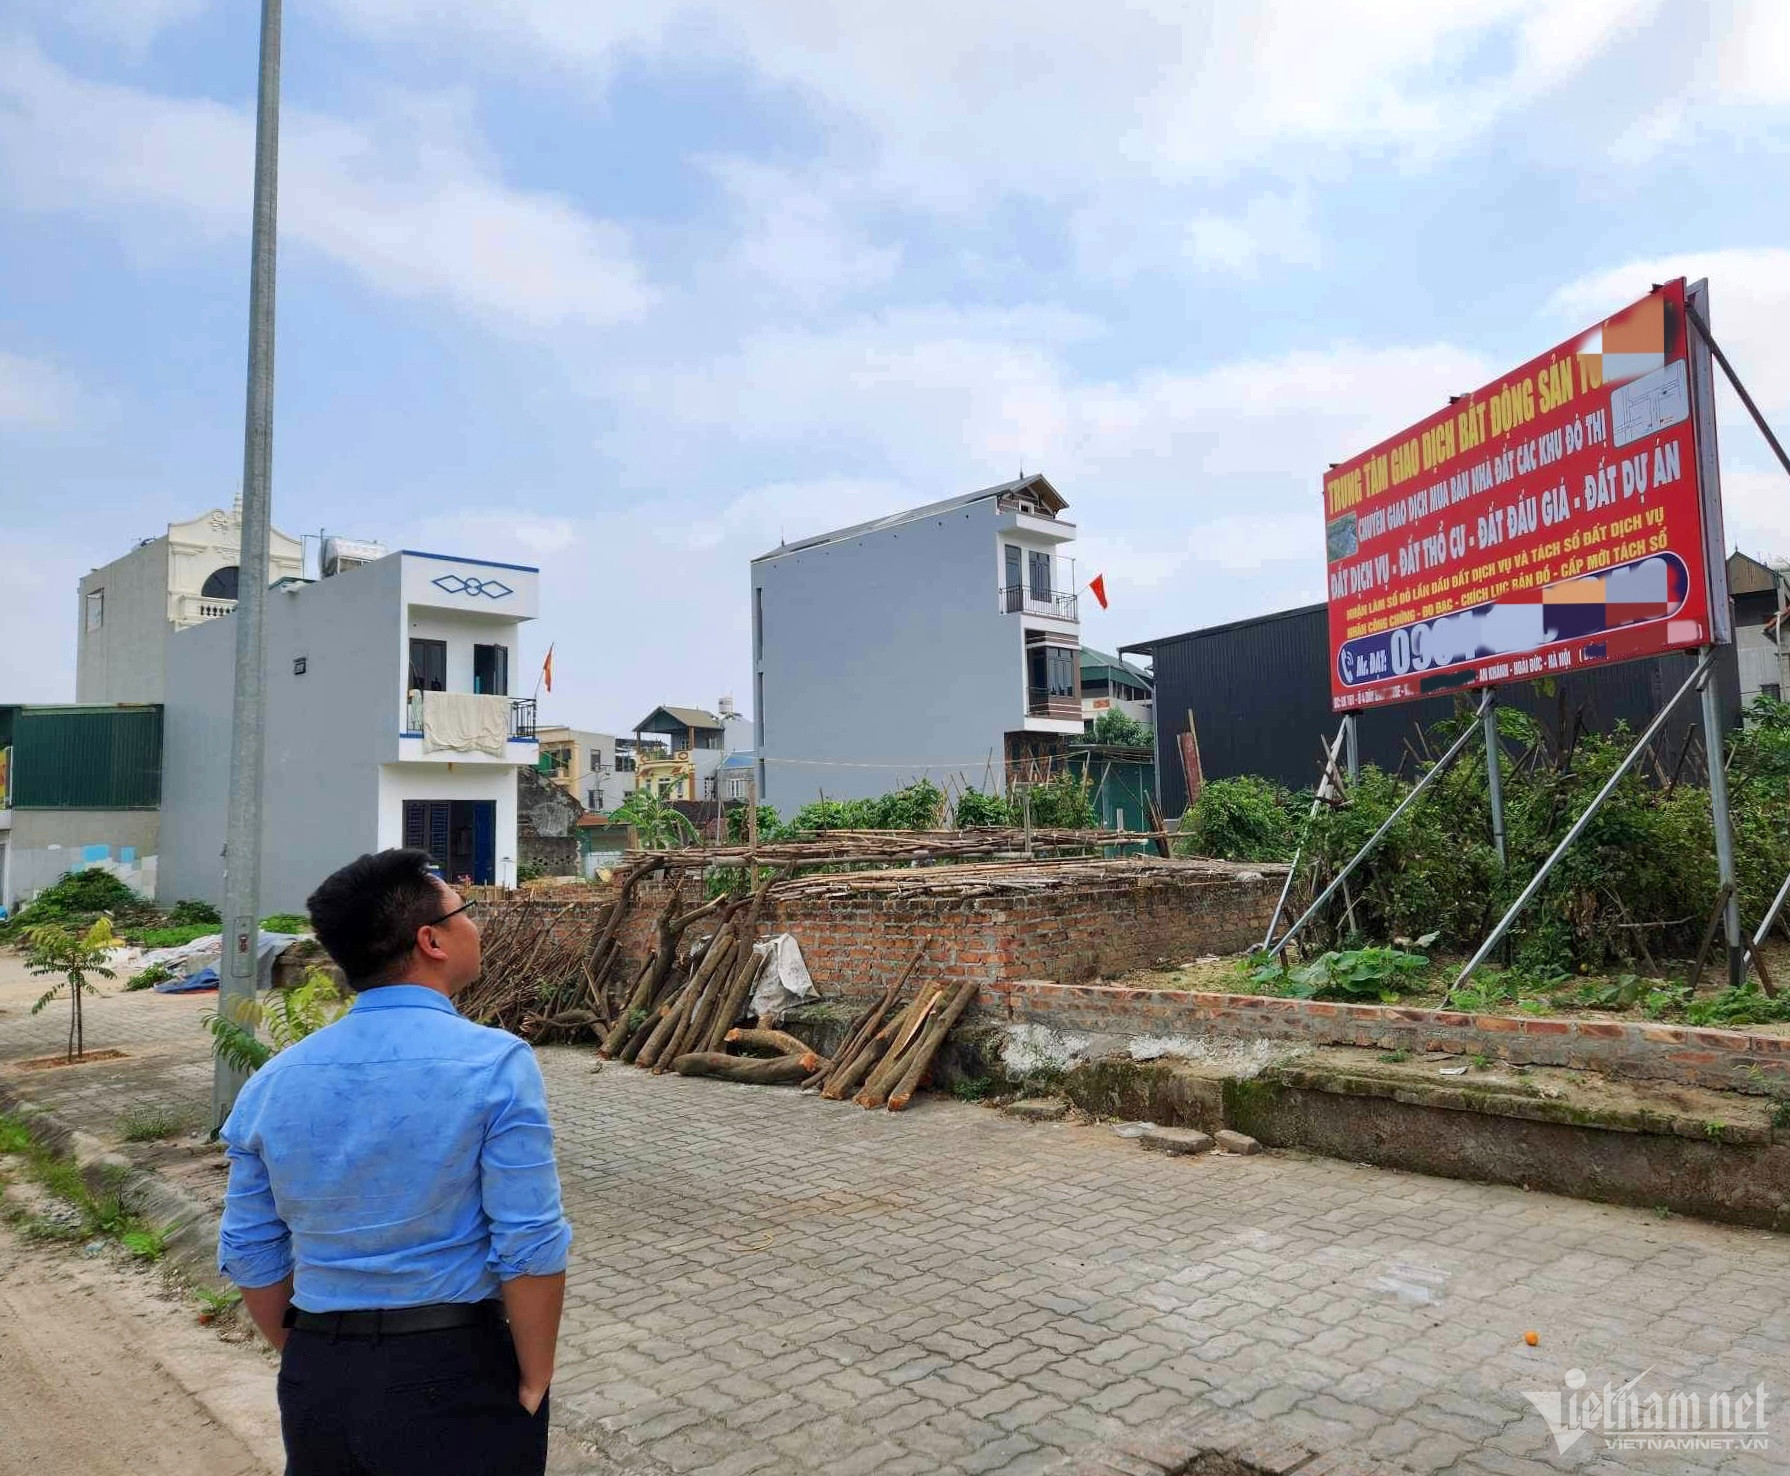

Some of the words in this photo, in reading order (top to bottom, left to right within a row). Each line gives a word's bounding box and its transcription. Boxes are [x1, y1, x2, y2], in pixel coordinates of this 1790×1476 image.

[1327, 467, 1362, 515] TRUNG
[1363, 453, 1389, 498] TÂM
[1391, 438, 1420, 486] GIAO
[1422, 418, 1456, 474] DỊCH
[1458, 394, 1486, 453] BẤT
[1490, 378, 1535, 439] ĐỘNG
[1538, 353, 1574, 414] SẢN
[1358, 505, 1386, 543] CHUYÊN
[1387, 499, 1407, 531] GIAO
[1408, 489, 1428, 526] DỊCH
[1430, 480, 1450, 513] MUA
[1450, 468, 1470, 504] BÁN
[1471, 455, 1493, 494] NHÀ
[1494, 443, 1514, 485] ĐẤT
[1517, 436, 1537, 475] CÁC
[1539, 428, 1562, 467] KHU
[1565, 413, 1583, 455] ĐÔ
[1585, 408, 1607, 448] THỊ
[1331, 561, 1348, 601] ĐẤT
[1350, 560, 1374, 599] DỊCH
[1375, 553, 1389, 591] VỤ
[1399, 534, 1420, 577] ĐẤT
[1423, 520, 1446, 569] THỔ
[1478, 501, 1503, 549] ĐẤT
[1507, 489, 1537, 539] ĐẤU
[1541, 476, 1571, 527] GIÁ
[1584, 456, 1616, 512] ĐẤT
[1621, 452, 1648, 504] DỰ
[1653, 438, 1681, 488] ÁN
[1368, 598, 1386, 613] LÀM
[1452, 568, 1470, 588] ĐẤT
[1472, 562, 1496, 583] DỊCH
[1498, 557, 1512, 574] VỤ
[1514, 550, 1529, 568] VÀ
[1531, 541, 1561, 563] TÁCH
[1583, 522, 1607, 546] ĐẤT
[1610, 513, 1642, 538] DỊCH
[1646, 506, 1665, 526] VỤ
[1461, 588, 1489, 606] CHÍCH
[1561, 554, 1584, 577] CẤP
[1587, 548, 1610, 571] MỚI
[1612, 540, 1646, 563] TÁCH
[1650, 525, 1668, 551] SỔ
[1480, 668, 1488, 682] AN
[1489, 663, 1509, 680] KHÁNH
[1530, 654, 1543, 673] ĐỨC
[1548, 651, 1558, 670] HÀ
[1559, 648, 1571, 669] NỘI
